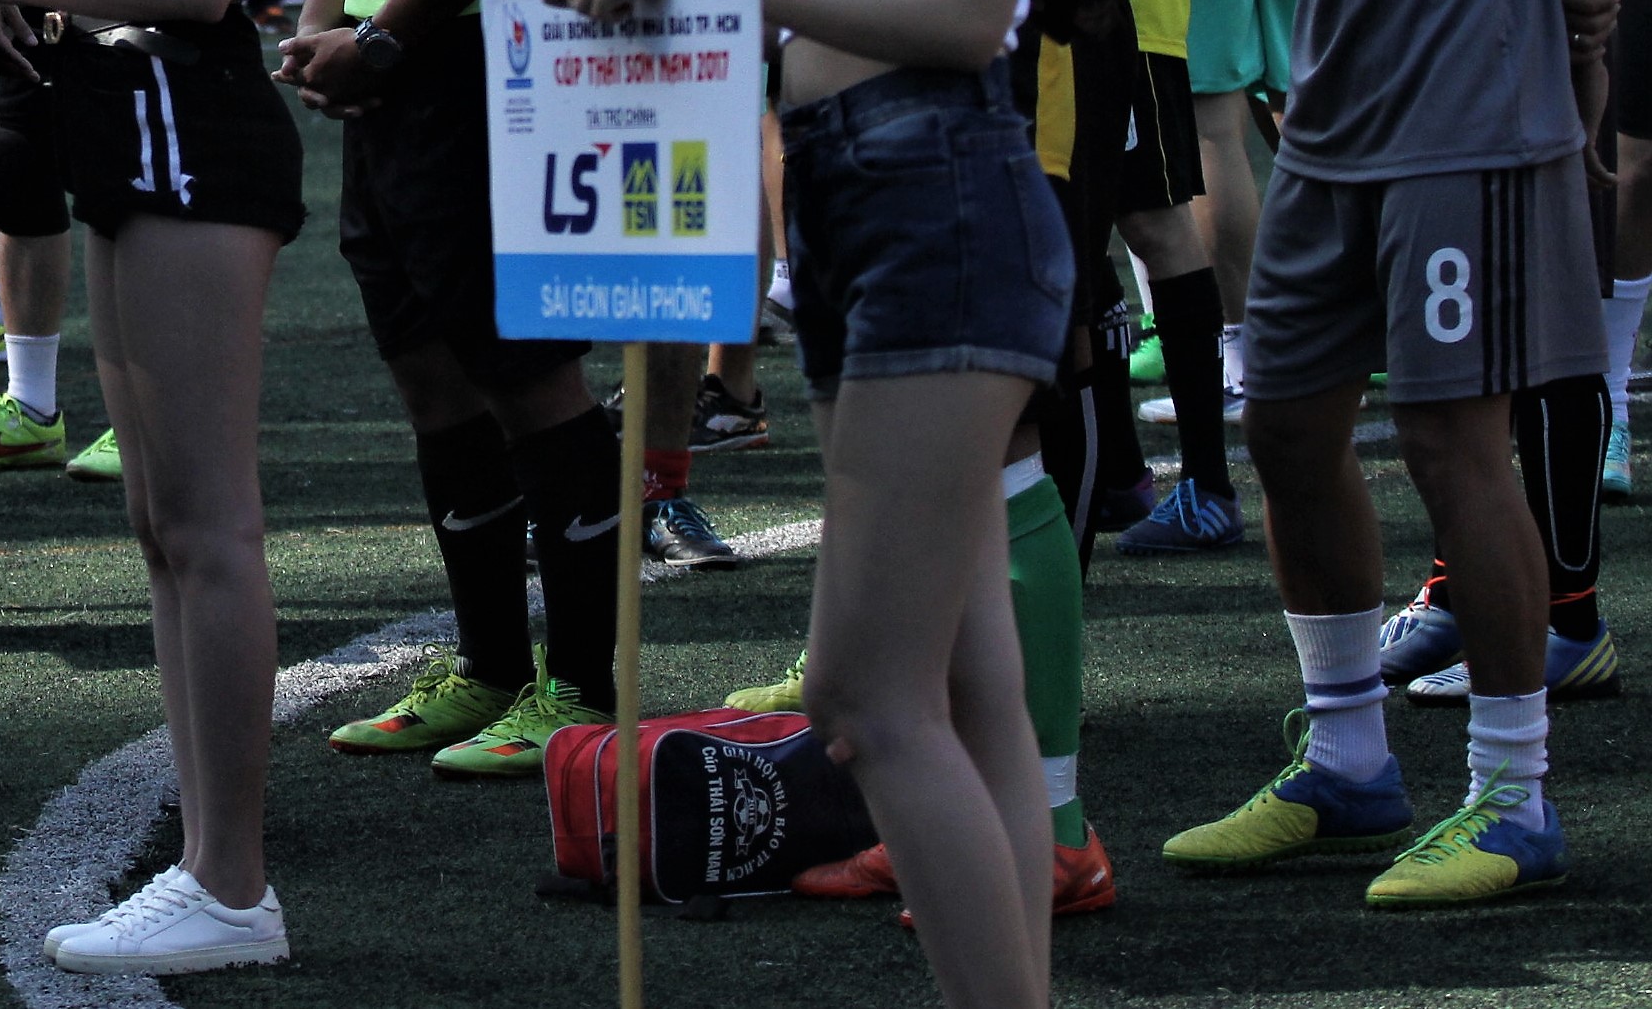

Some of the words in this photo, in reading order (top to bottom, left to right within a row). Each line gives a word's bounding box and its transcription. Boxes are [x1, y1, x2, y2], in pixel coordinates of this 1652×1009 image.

[554, 51, 583, 86] CÚP
[587, 48, 622, 86] THÁI
[544, 153, 598, 234] LS
[673, 200, 705, 231] TSB
[541, 275, 569, 319] SÀI
[572, 276, 609, 319] GÒN
[612, 276, 648, 320] GIẢI
[650, 276, 713, 321] PHÓNG
[1425, 247, 1475, 344] 8
[702, 746, 719, 774] Cúp
[754, 755, 778, 780] HỘI
[708, 777, 728, 813] THÁI
[709, 817, 726, 847] SƠN
[705, 851, 723, 882] NAM
